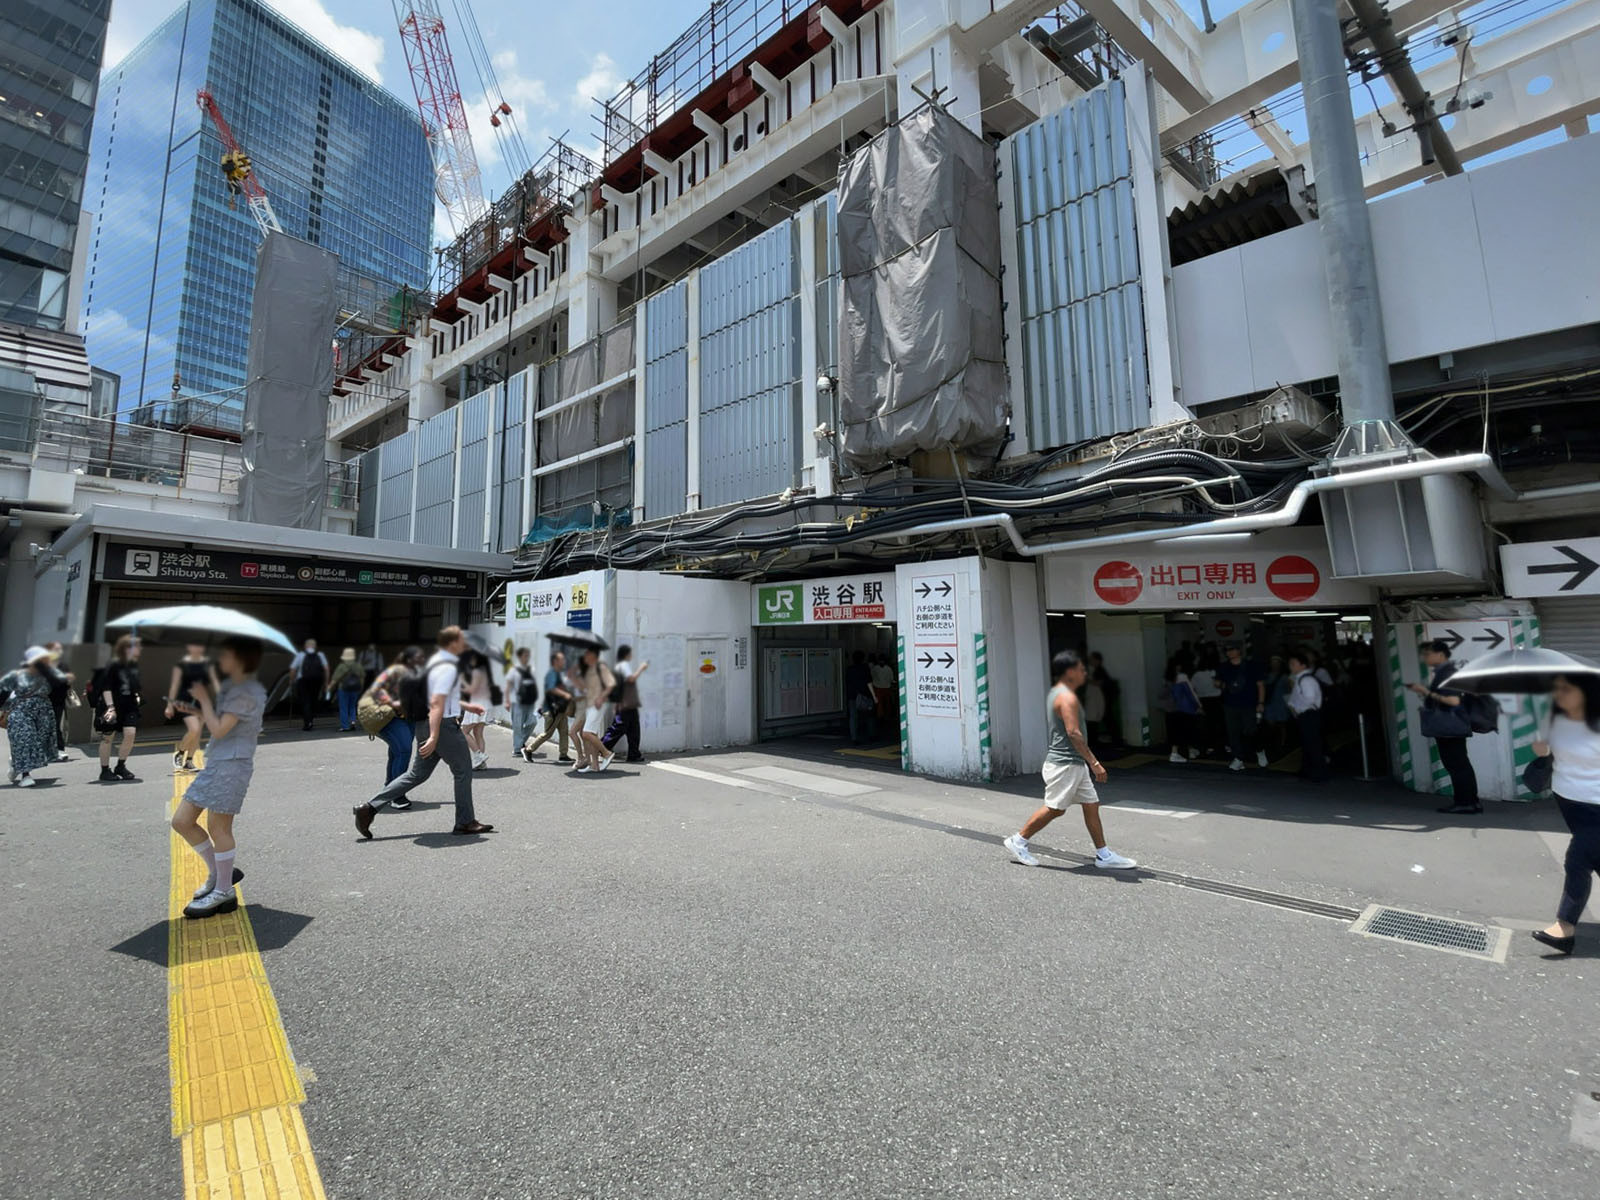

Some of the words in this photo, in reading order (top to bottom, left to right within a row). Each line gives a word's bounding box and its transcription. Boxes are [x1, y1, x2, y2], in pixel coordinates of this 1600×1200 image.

[162, 552, 211, 568] 渋谷駅
[161, 566, 206, 580] Shibuya
[208, 571, 228, 580] Sta.
[244, 566, 256, 574] TY
[1151, 562, 1257, 587] 出口専用
[578, 590, 588, 605] B7
[812, 581, 884, 606] 渋谷駅
[1178, 592, 1200, 601] EXIT
[1207, 591, 1236, 600] ONLY
[517, 594, 530, 611] JR
[532, 593, 552, 608] 渋谷駅
[766, 590, 794, 612] JR
[855, 606, 883, 614] ENTRANCE
[917, 604, 951, 612] ハチ公側へは
[815, 608, 853, 620] 入口専用
[916, 613, 953, 621] 右側の歩道を
[915, 622, 955, 630] ご利用ください
[919, 676, 954, 684] ハチ公側へは
[918, 685, 956, 693] 右側の歩道を
[918, 693, 958, 702] ご利用ください
